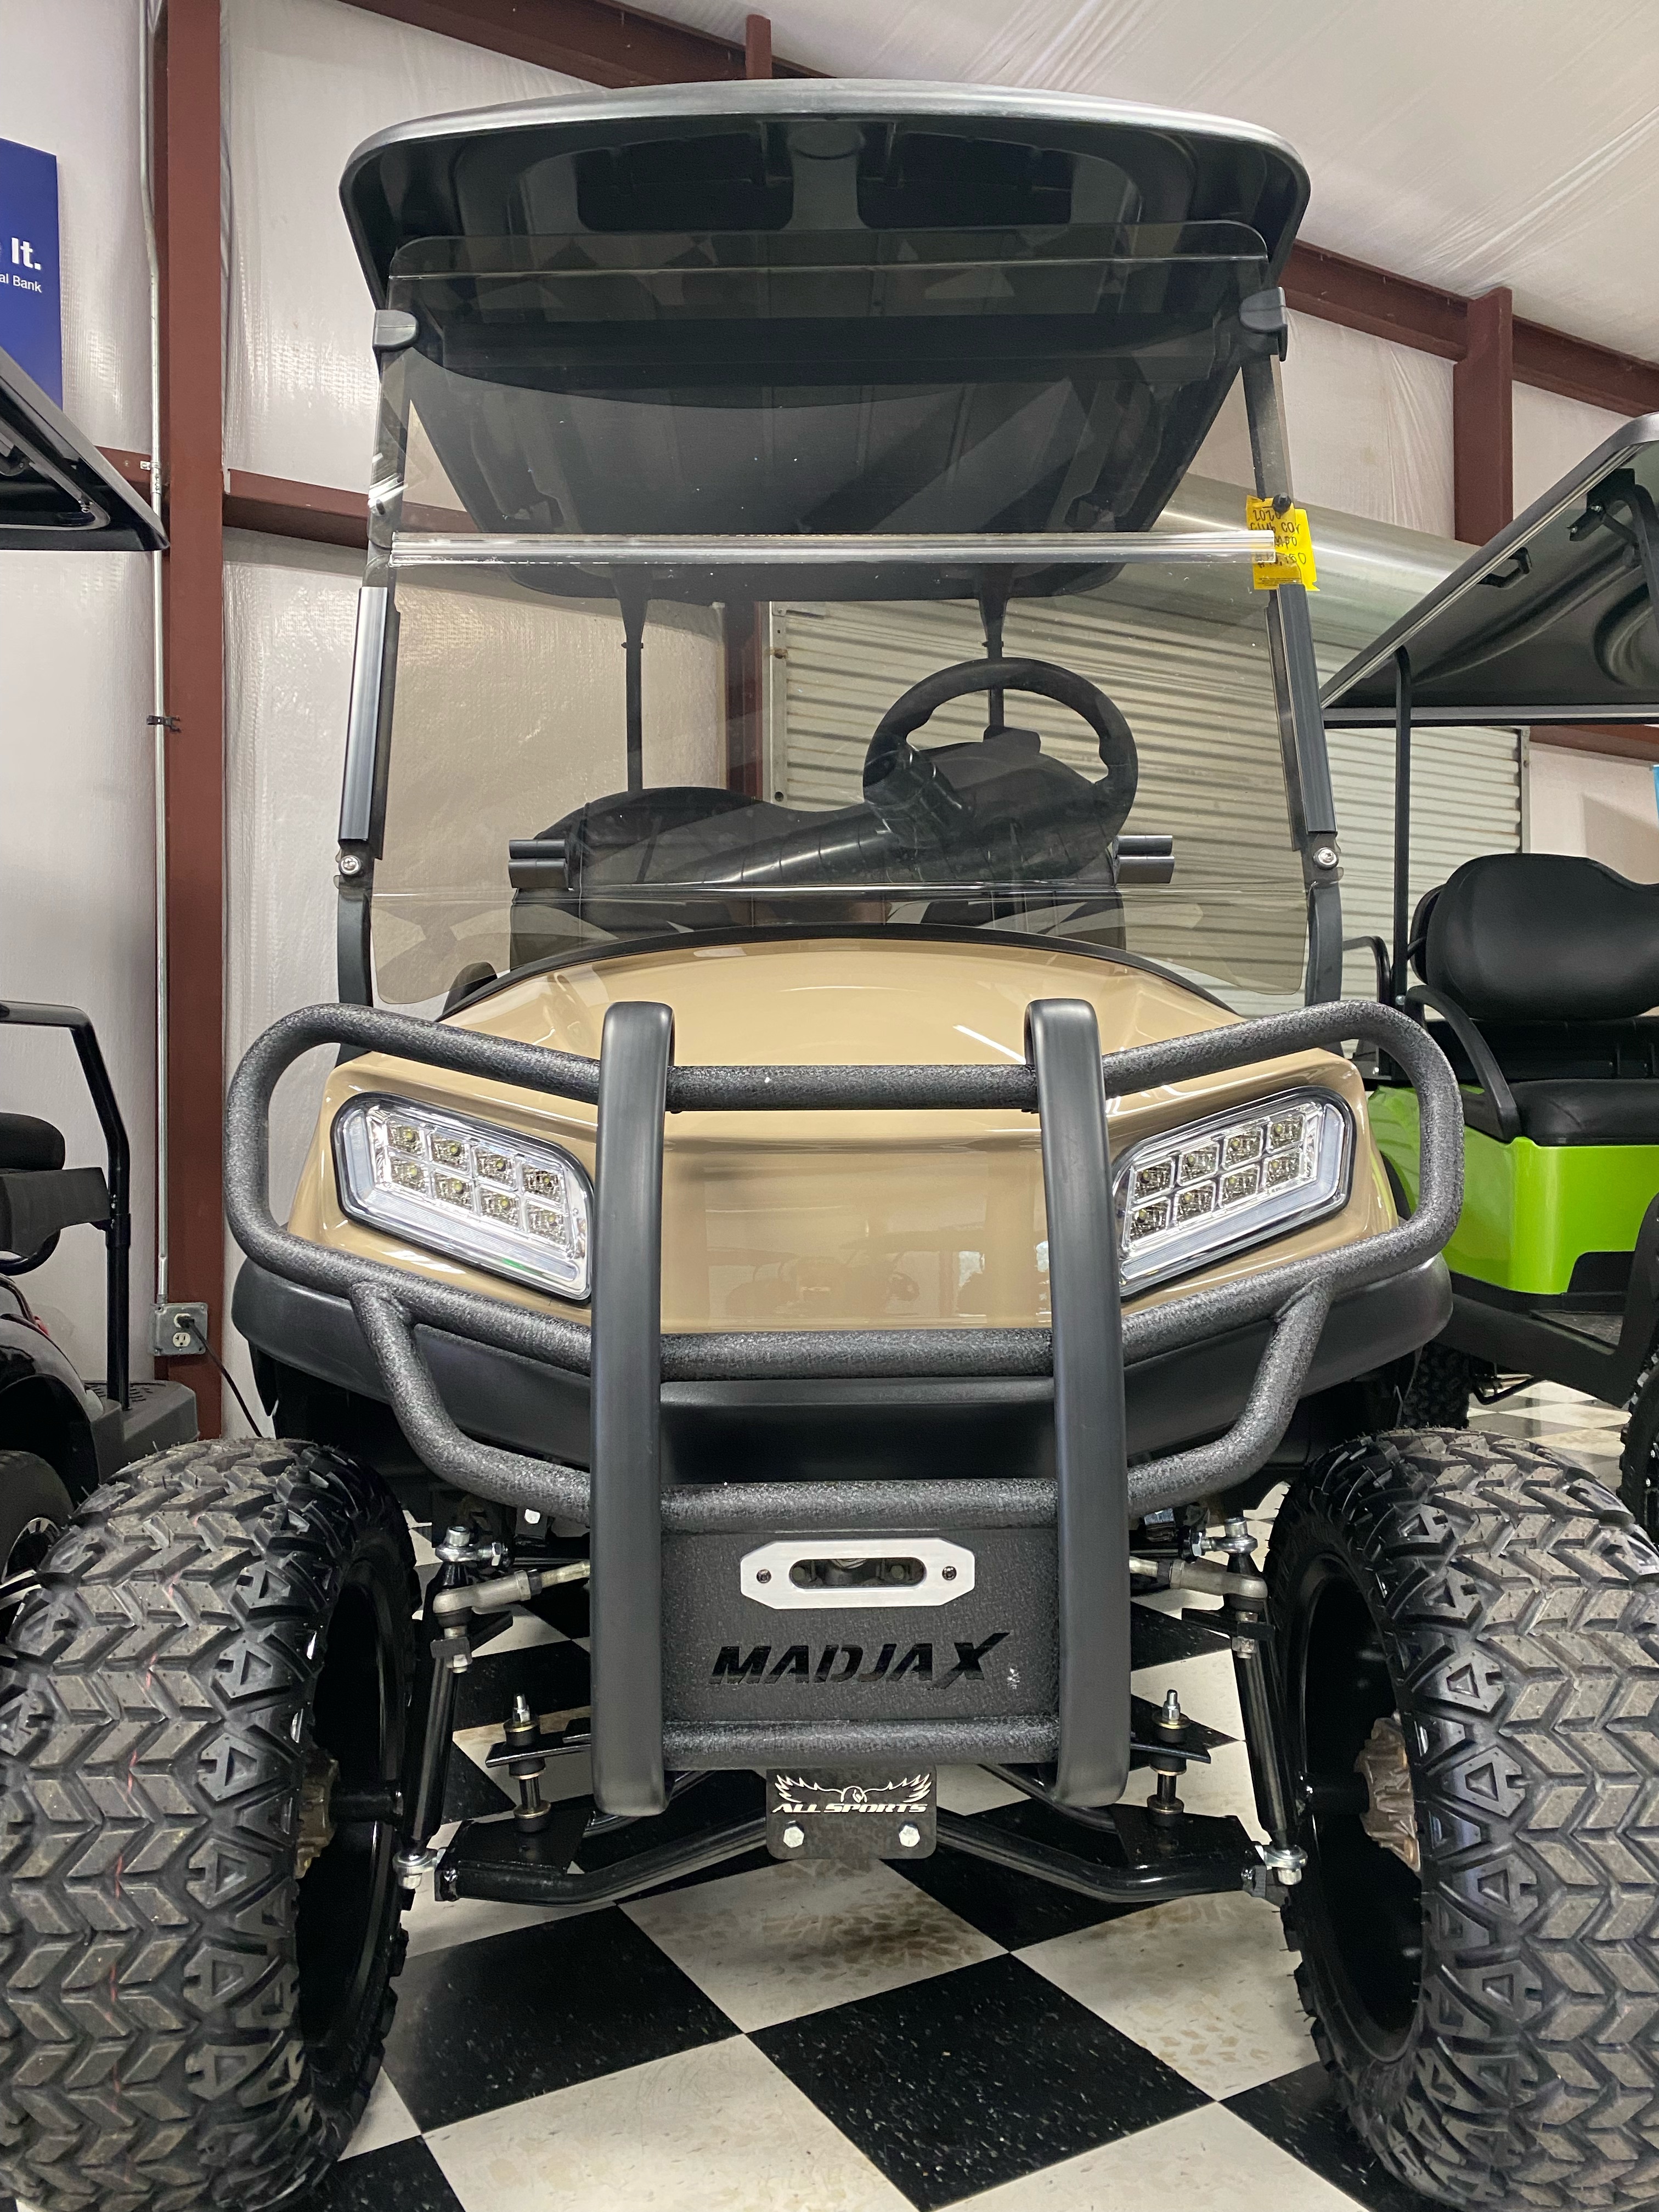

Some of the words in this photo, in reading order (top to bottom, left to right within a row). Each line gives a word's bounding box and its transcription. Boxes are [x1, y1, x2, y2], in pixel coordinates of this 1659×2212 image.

[11, 237, 42, 270] It.
[13, 275, 42, 293] Bank
[708, 1632, 1010, 1690] MADJAX
[771, 1803, 821, 1813] ALL
[823, 1803, 929, 1813] SPORTS
